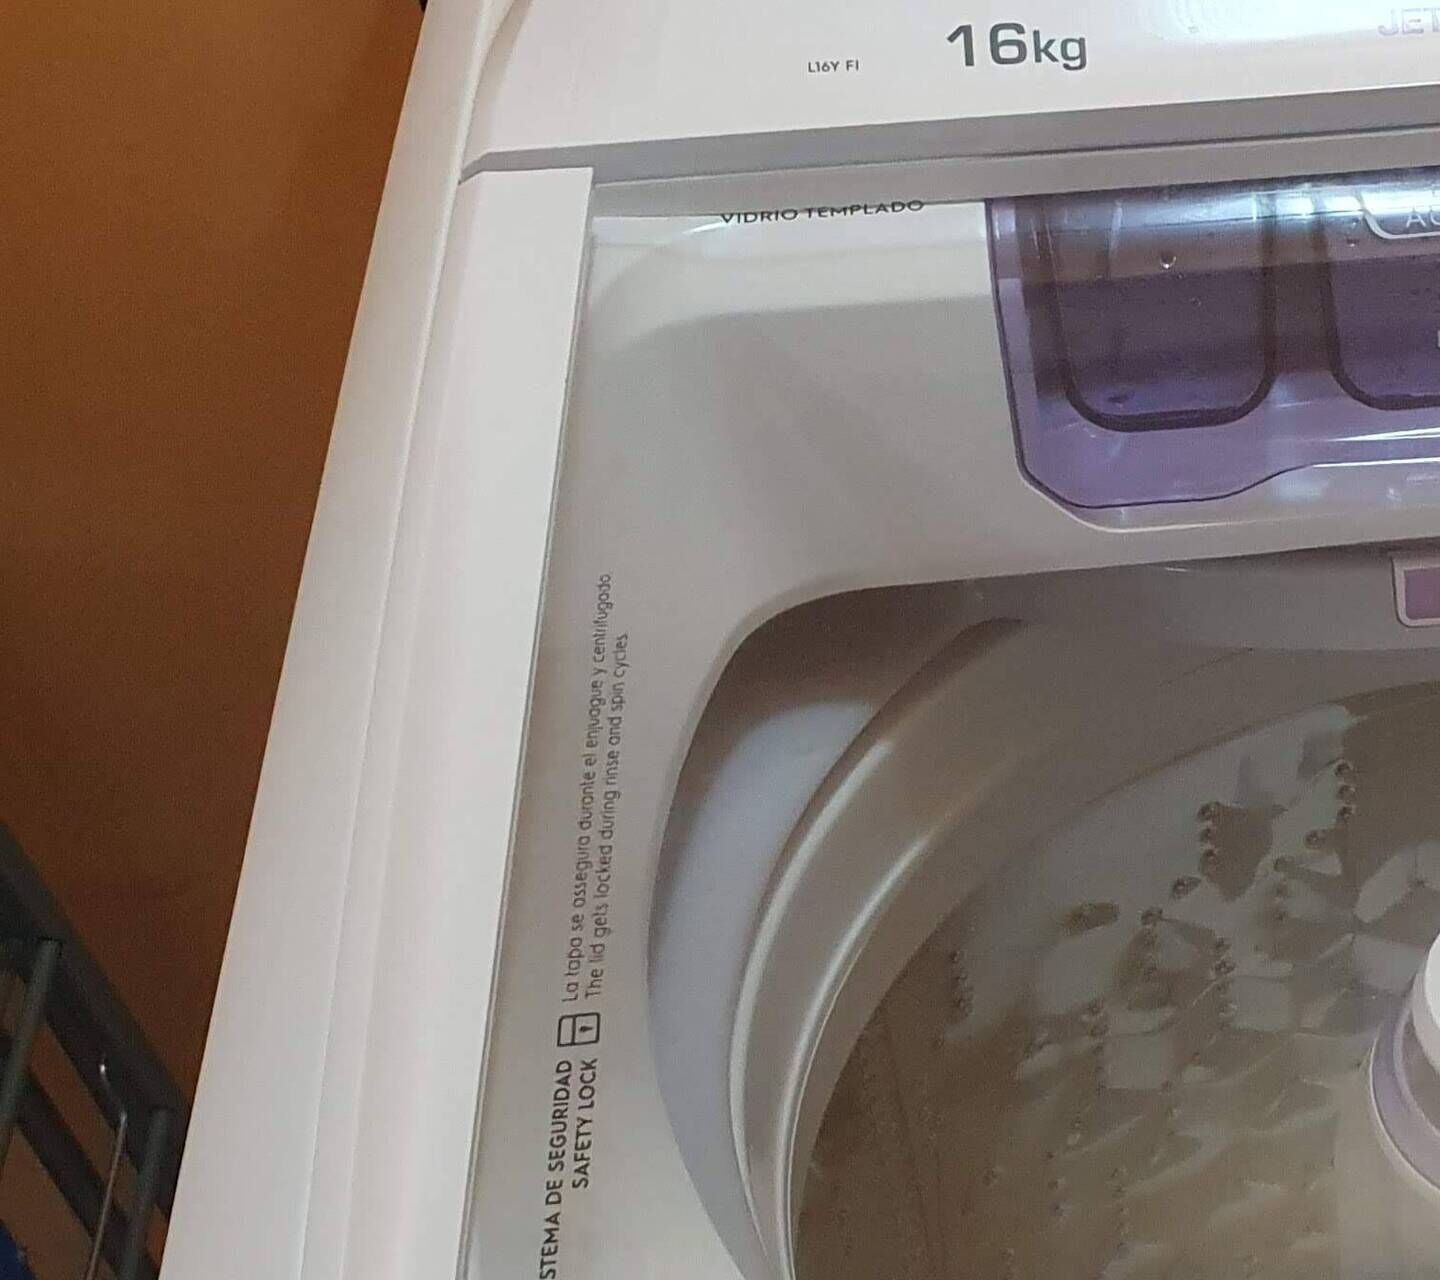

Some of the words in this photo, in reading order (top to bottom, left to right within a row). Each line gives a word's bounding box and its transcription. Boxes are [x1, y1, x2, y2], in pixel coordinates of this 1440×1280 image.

[946, 23, 1087, 71] 16kg
[808, 60, 840, 73] L16Y
[721, 208, 799, 224] VIDRIO
[803, 200, 925, 219] TEMPLADO
[593, 667, 607, 675] y
[611, 682, 626, 711] spin
[585, 681, 606, 748] enjuague
[608, 716, 622, 746] and
[582, 753, 597, 766] el
[604, 751, 619, 785] rinse
[579, 772, 596, 830] durante
[599, 791, 620, 839] during
[594, 845, 612, 898] locked
[570, 914, 584, 931] se
[593, 904, 611, 938] gets
[565, 937, 583, 975] tapa
[590, 944, 605, 962] lid
[562, 982, 579, 1002] La
[585, 969, 604, 998] The
[579, 1058, 597, 1109] LOCK
[549, 1060, 573, 1171] SEGURIDAD
[572, 1116, 593, 1188] SAFETY
[546, 1179, 563, 1205] DE
